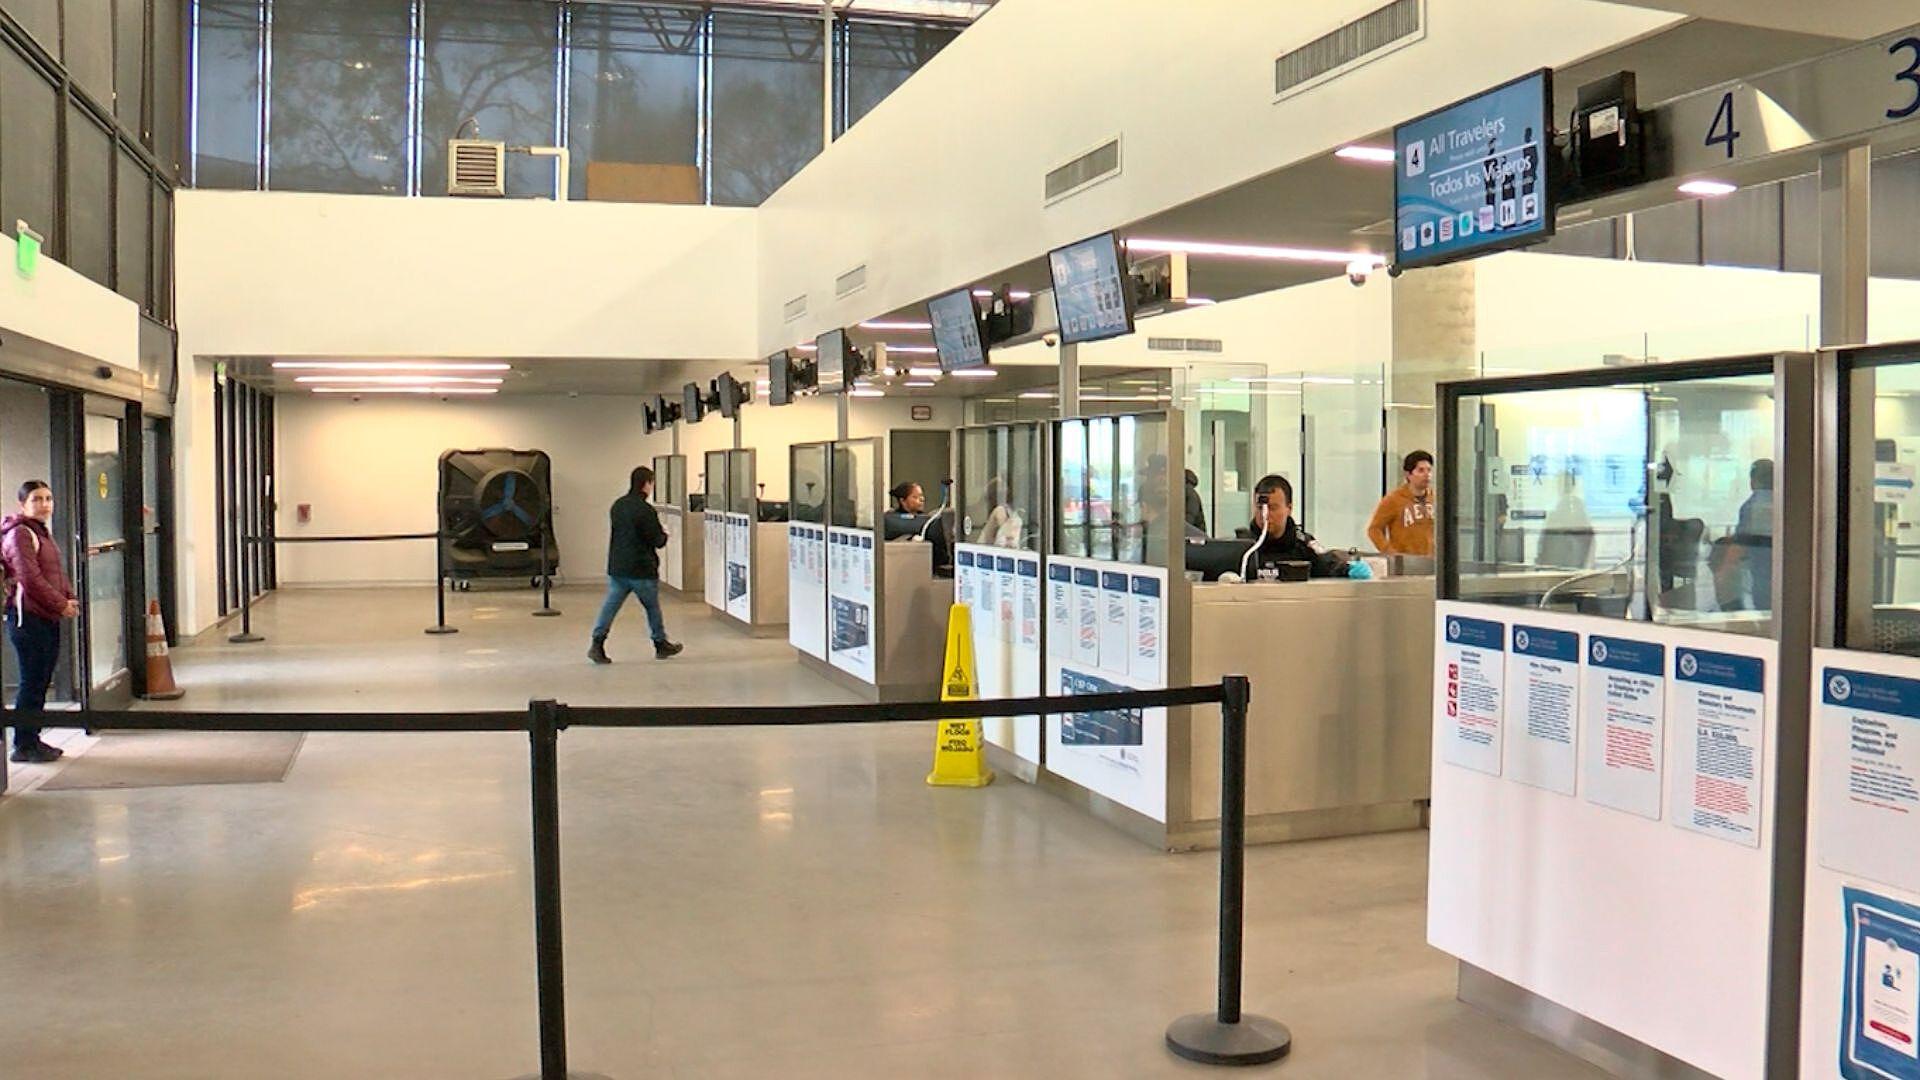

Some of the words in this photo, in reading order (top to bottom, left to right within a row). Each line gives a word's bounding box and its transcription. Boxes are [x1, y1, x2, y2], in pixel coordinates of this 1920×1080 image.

[1885, 37, 1920, 118] 3
[1429, 132, 1446, 156] All
[1447, 117, 1505, 150] Travelers
[1705, 92, 1740, 158] 4
[1411, 148, 1419, 167] 4
[1430, 174, 1463, 198] Todos
[1464, 169, 1481, 188] los
[1483, 156, 1532, 183] Viajeros
